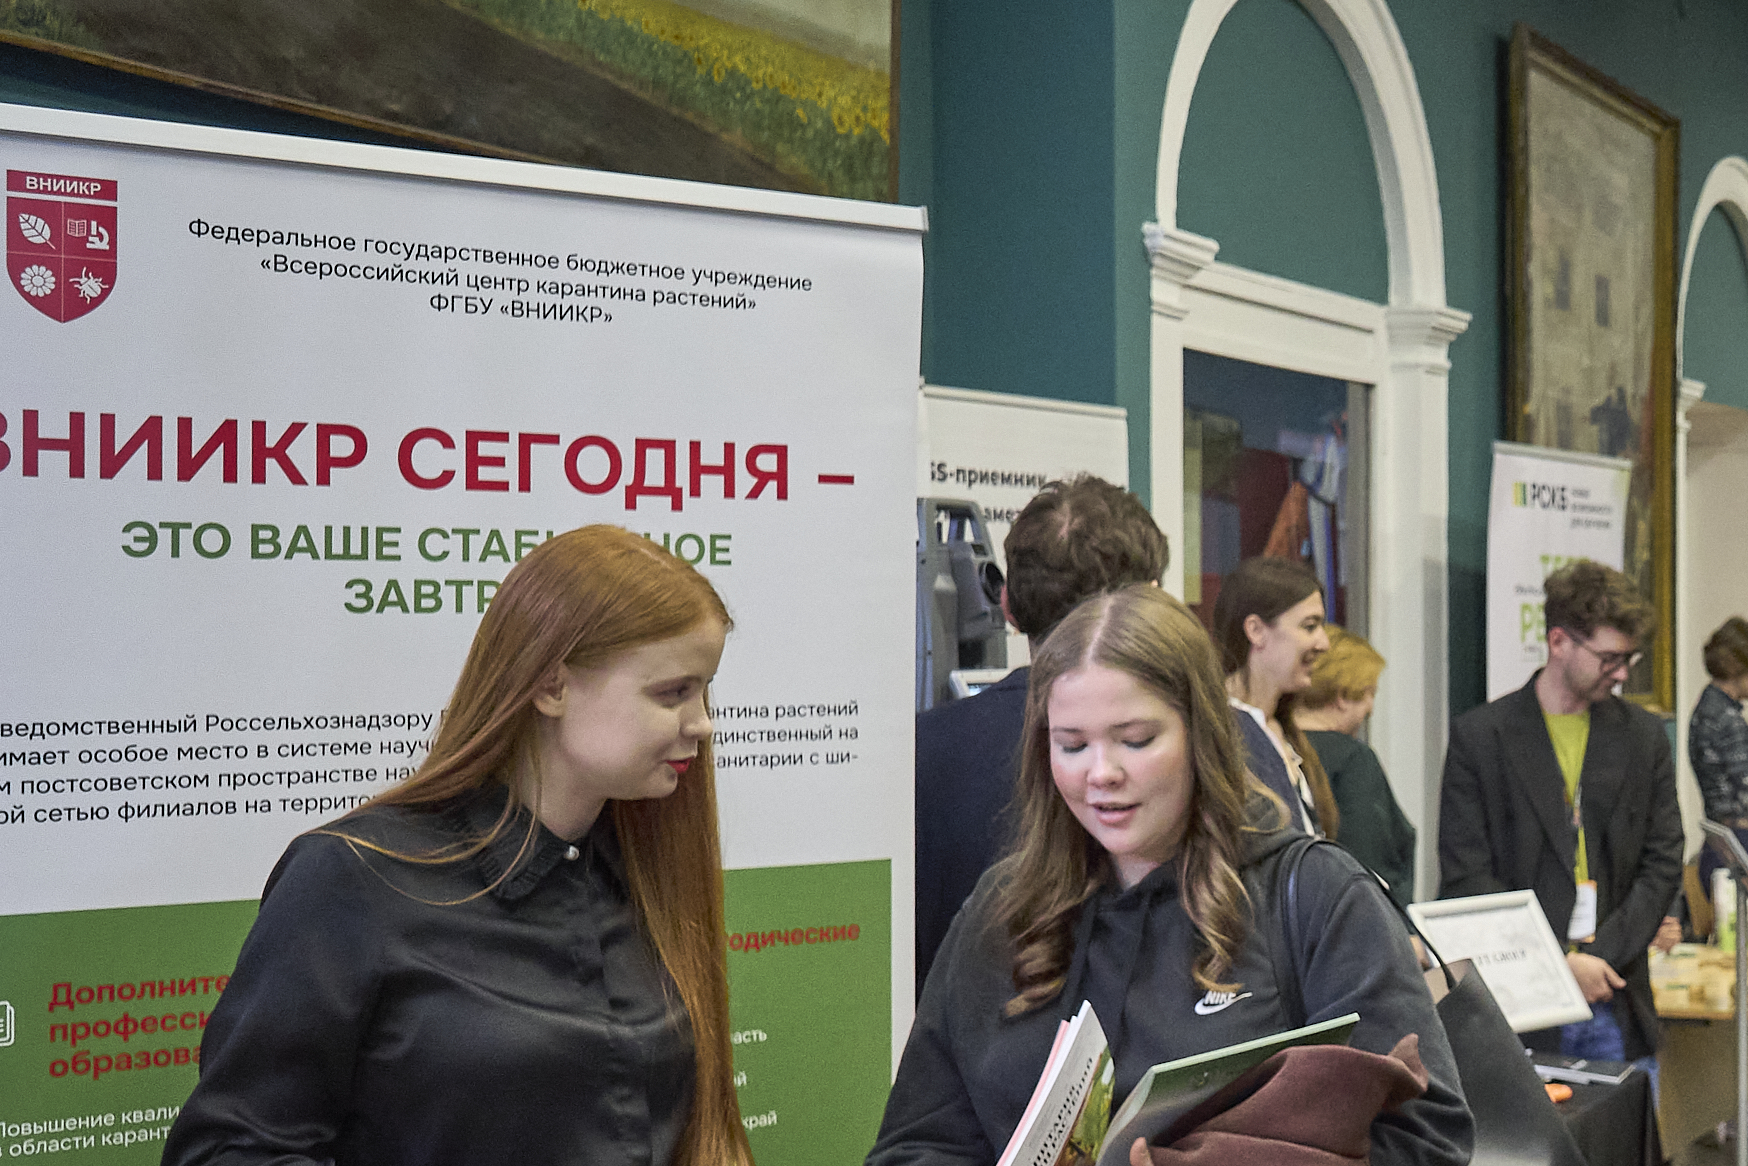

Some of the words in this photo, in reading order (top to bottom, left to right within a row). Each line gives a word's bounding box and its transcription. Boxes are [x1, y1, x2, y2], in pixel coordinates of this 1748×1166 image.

[26, 176, 102, 196] ВНИИКР
[188, 218, 356, 252] Федеральное
[364, 238, 560, 271] государственное
[566, 253, 685, 281] бюджетное
[692, 267, 812, 293] учреждение
[260, 254, 459, 287] «Всероссийский
[466, 272, 529, 294] центр
[536, 281, 646, 302] карантина
[652, 287, 757, 311] растений»
[429, 293, 494, 316] ФГБУ
[500, 299, 613, 324] «ВНИИКР»
[0, 408, 368, 487] НИИКР
[397, 426, 790, 511] СЕГОДНЯ
[120, 521, 232, 559] ЭТО
[250, 524, 402, 563] ВАШЕ
[205, 710, 433, 733] Россельхознадзору
[775, 700, 859, 721] растений
[838, 727, 859, 741] на
[78, 744, 168, 764] особое
[177, 744, 248, 762] место
[256, 743, 269, 759] в
[277, 740, 372, 757] системе
[810, 753, 820, 766] с
[825, 751, 859, 765] ши-
[20, 775, 209, 796] постсоветском
[217, 767, 377, 791] пространстве
[34, 803, 110, 824] сетью
[117, 798, 237, 823] филиалов
[245, 798, 271, 815] на
[9, 1128, 95, 1158] области
